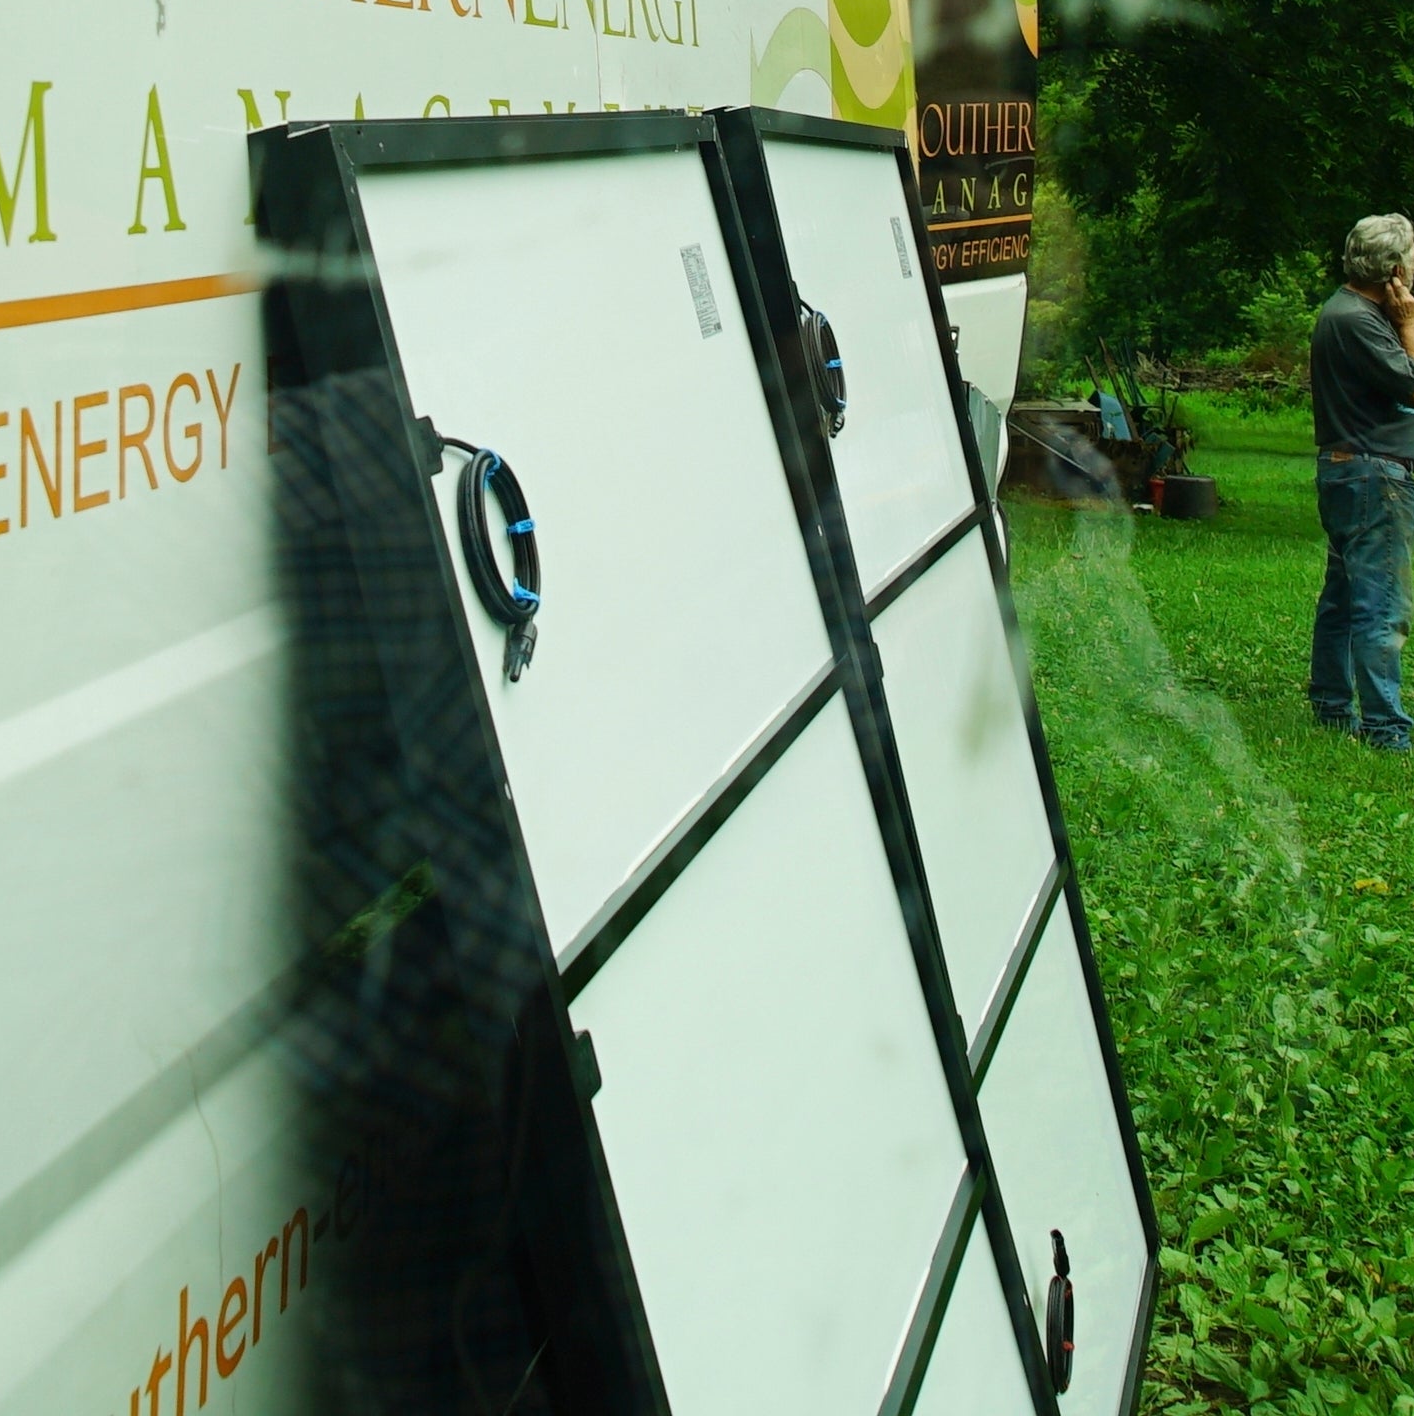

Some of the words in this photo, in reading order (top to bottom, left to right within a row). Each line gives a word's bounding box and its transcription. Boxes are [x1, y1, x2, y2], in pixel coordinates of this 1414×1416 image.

[920, 101, 1035, 160] OUTHER
[931, 172, 1027, 215] ANAG
[961, 233, 1030, 267] EFFICIENC
